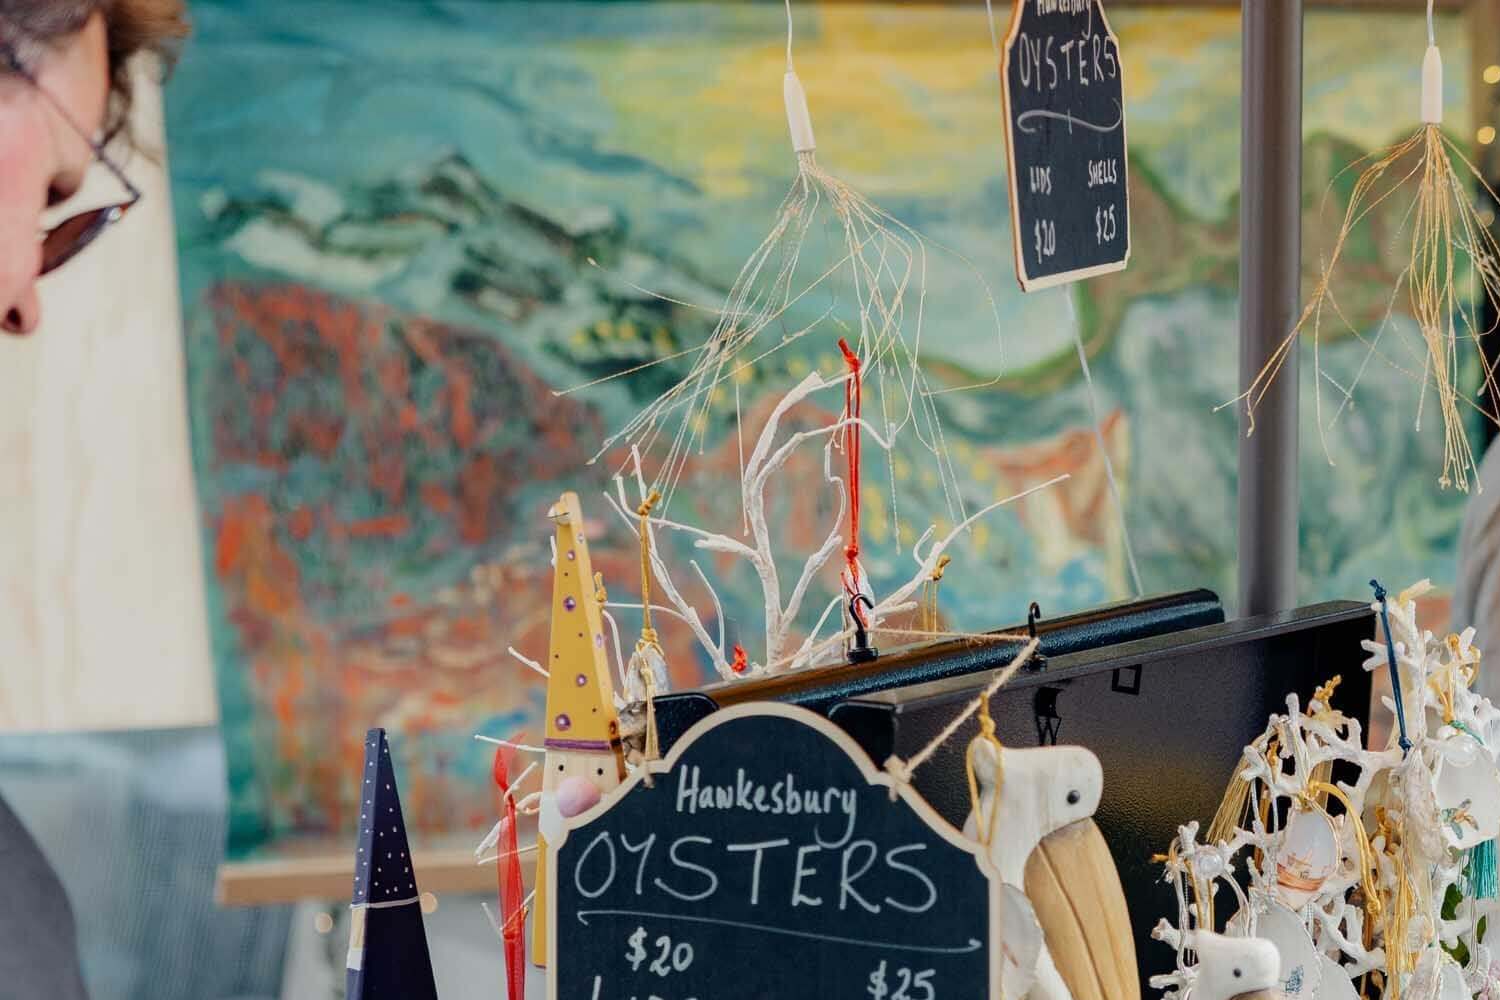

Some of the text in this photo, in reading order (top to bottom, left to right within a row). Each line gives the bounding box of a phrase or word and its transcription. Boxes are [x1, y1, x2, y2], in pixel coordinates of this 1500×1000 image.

[1019, 32, 1117, 92] OYSTERS
[1030, 165, 1052, 195] LIDS
[1087, 158, 1117, 189] SHELLS
[1034, 218, 1056, 264] $20
[1095, 203, 1116, 246] $25
[675, 763, 857, 850] Hawkesbury
[574, 831, 938, 914] OYSTERS
[625, 926, 694, 977] $20
